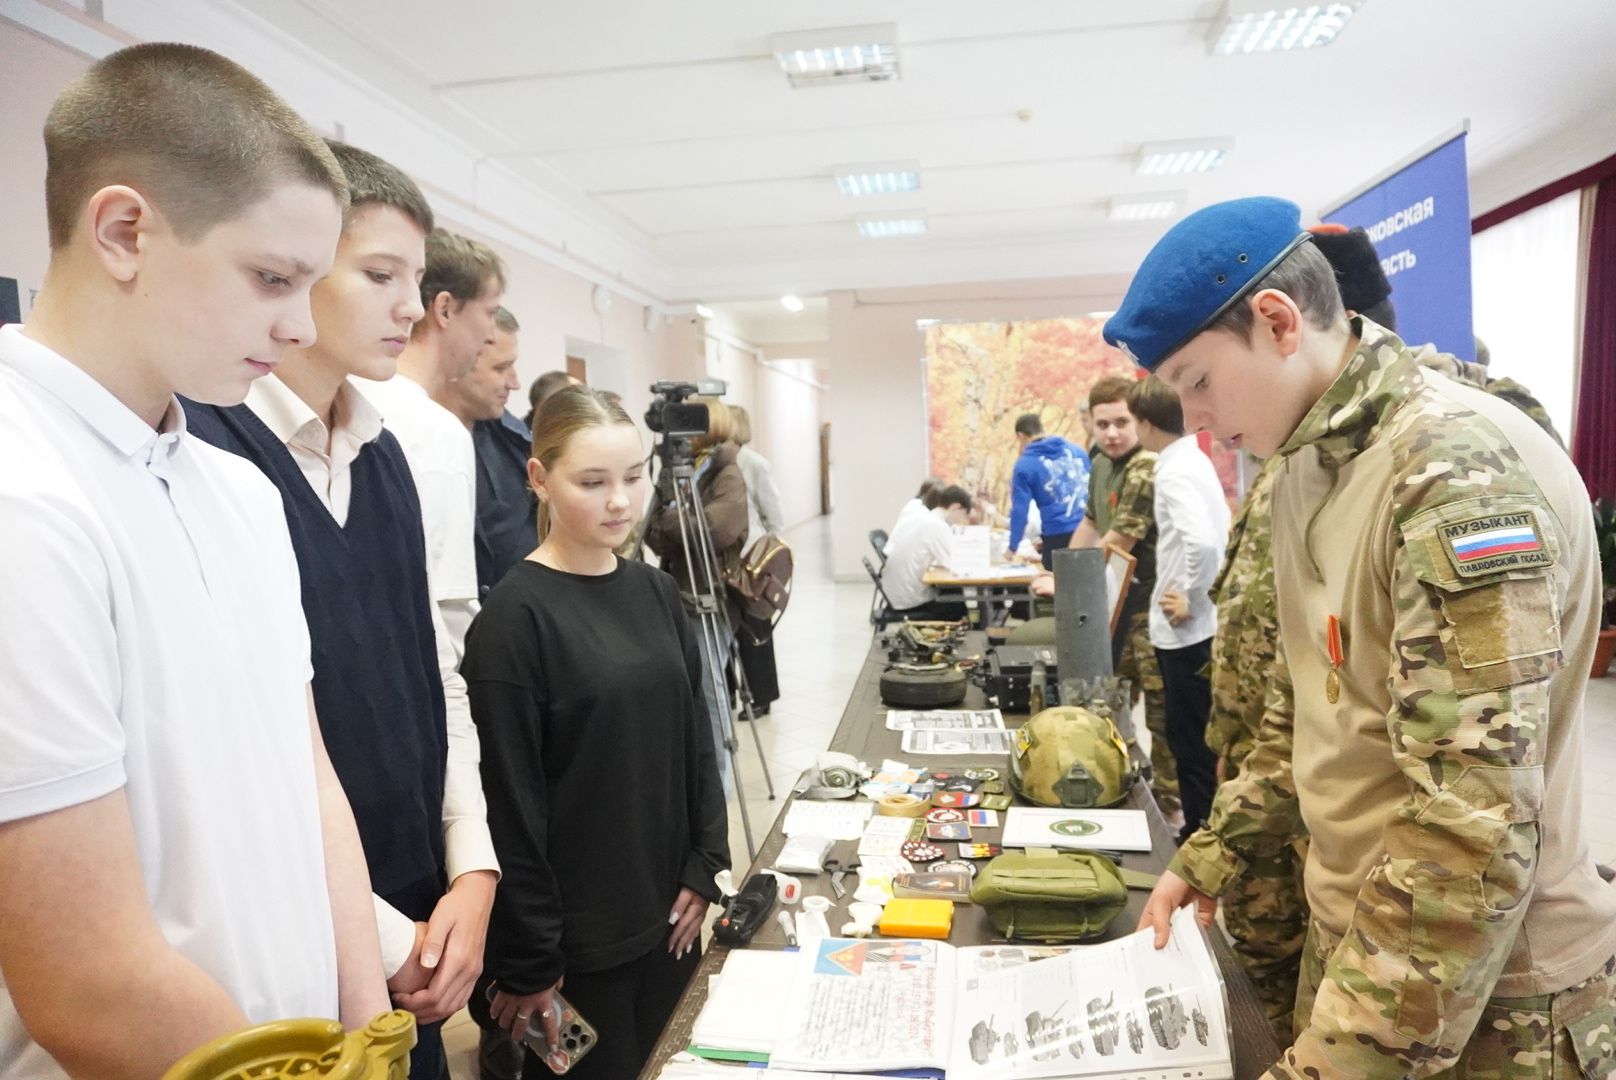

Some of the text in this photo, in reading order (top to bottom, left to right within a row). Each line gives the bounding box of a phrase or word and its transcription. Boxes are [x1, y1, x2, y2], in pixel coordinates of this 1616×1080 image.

[1365, 196, 1434, 243] ковская
[1380, 249, 1416, 277] асть
[1444, 515, 1529, 538] МУЗЫКАНТ
[1459, 553, 1549, 573] ПАВЛОВСКИЙ ПОСАД
